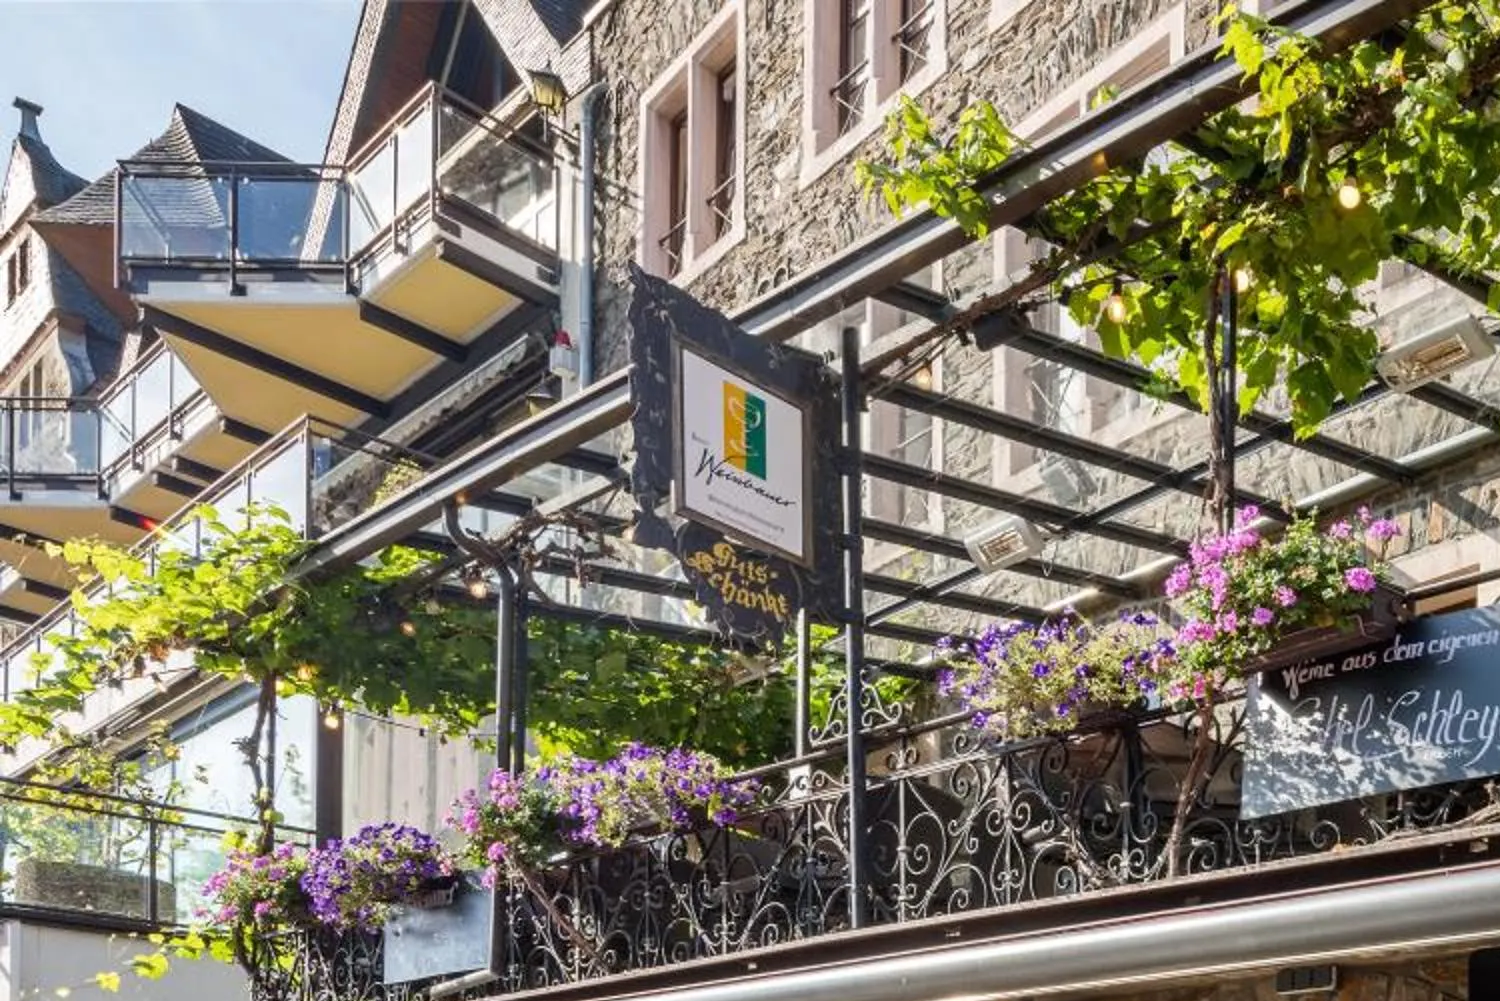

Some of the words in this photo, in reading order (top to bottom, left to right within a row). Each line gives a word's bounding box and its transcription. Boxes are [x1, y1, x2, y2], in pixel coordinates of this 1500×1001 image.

[1281, 657, 1336, 700] Weine
[1341, 651, 1377, 672] aus
[1383, 634, 1424, 663] dem
[1427, 628, 1499, 665] eigenen
